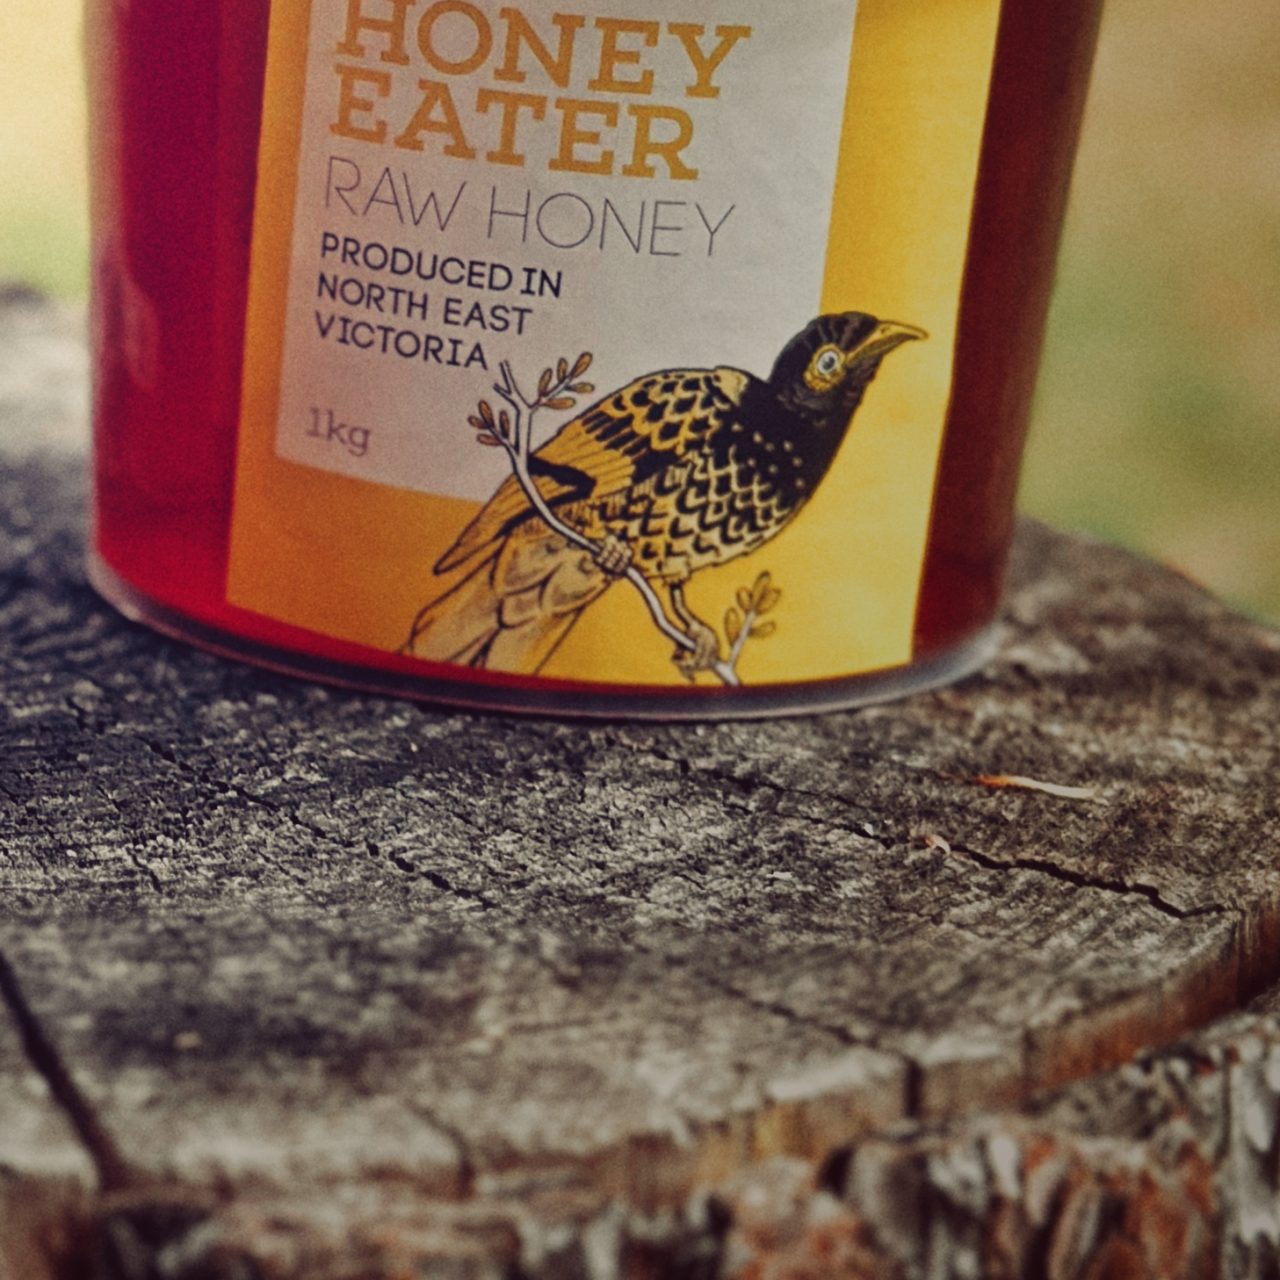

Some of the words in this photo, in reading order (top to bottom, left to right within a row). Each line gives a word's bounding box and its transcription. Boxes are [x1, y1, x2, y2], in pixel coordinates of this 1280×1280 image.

[328, 63, 700, 181] EATER
[324, 156, 467, 232] RAW
[487, 185, 736, 258] HONEY
[320, 232, 513, 293] PRODUCED
[522, 267, 563, 299] IN
[317, 273, 428, 321] NORTH
[443, 298, 533, 336] EAST
[314, 311, 489, 371] VICTORIA
[304, 407, 372, 457] 1kg
